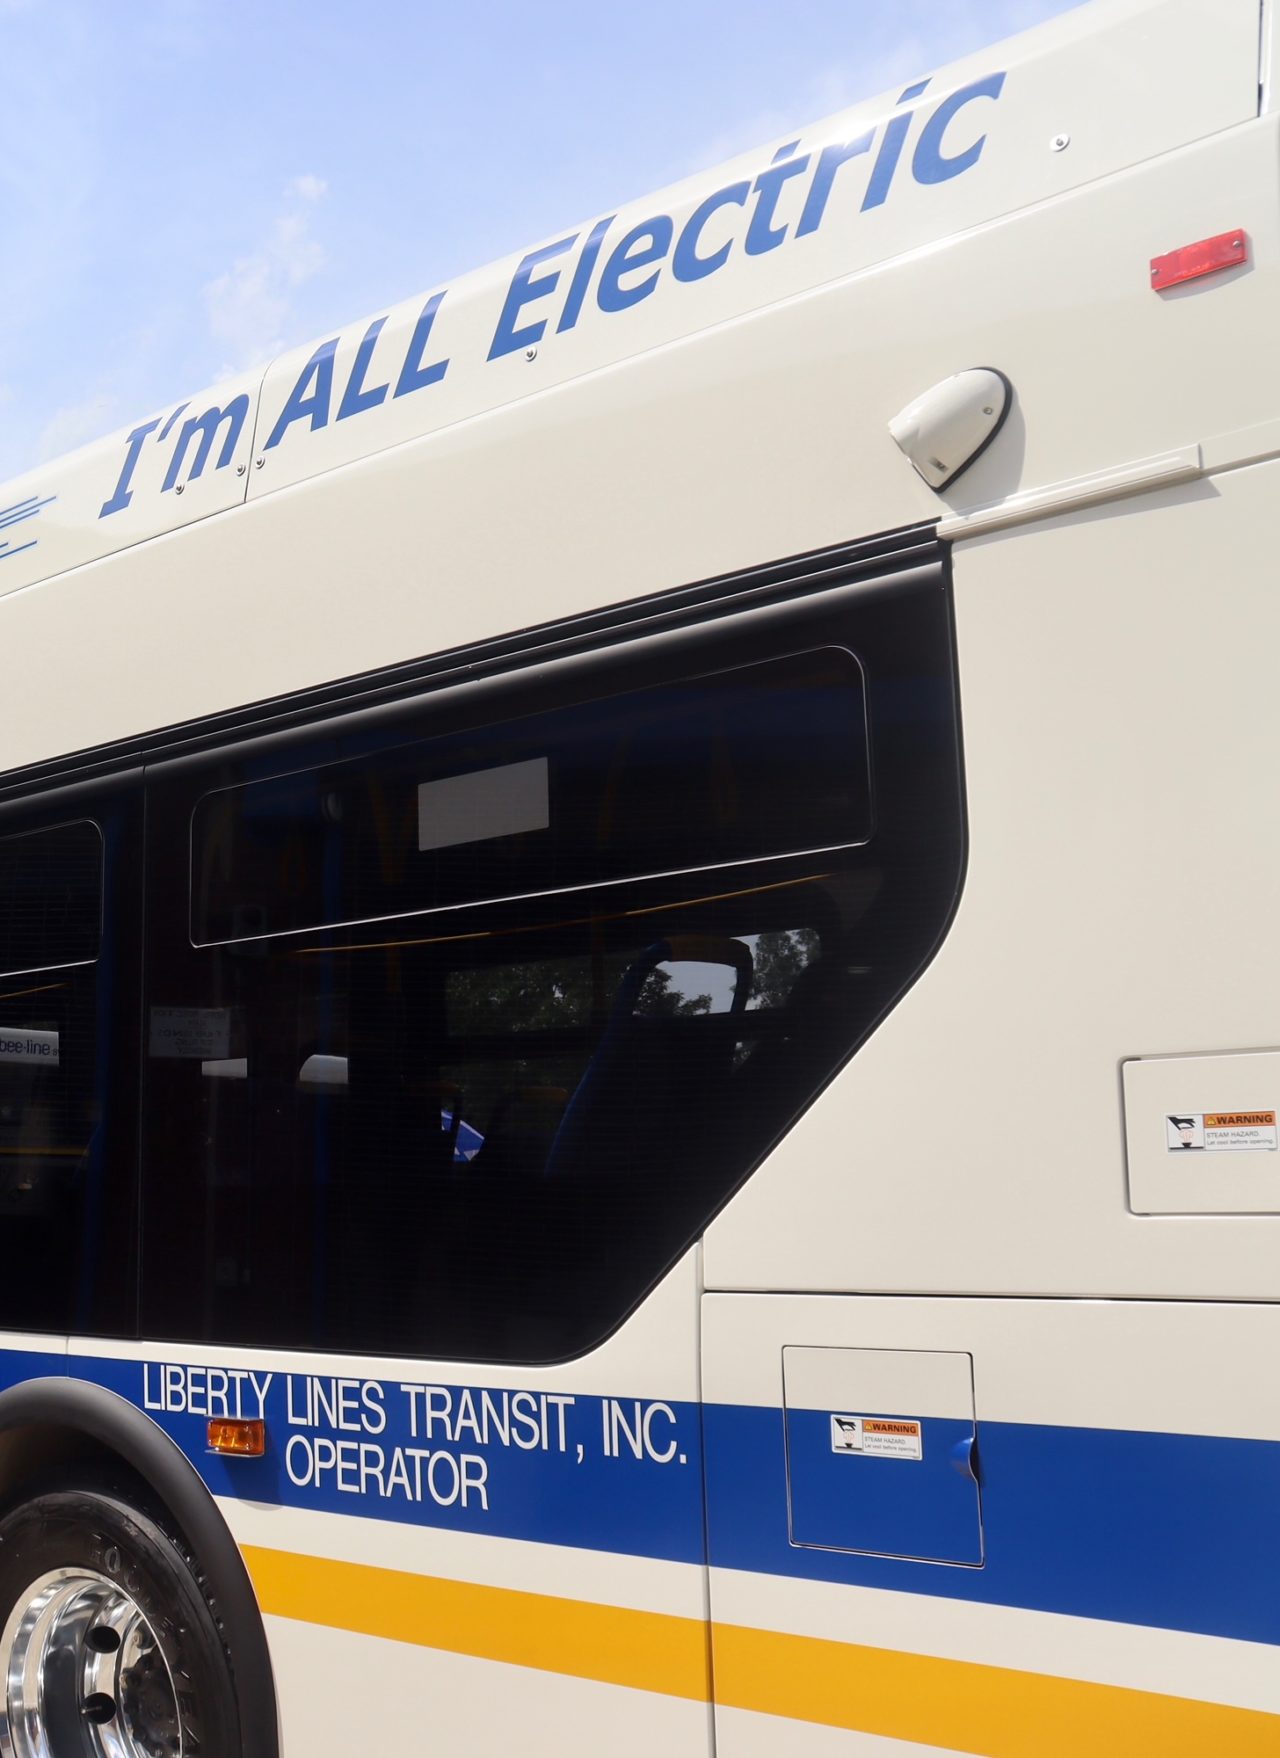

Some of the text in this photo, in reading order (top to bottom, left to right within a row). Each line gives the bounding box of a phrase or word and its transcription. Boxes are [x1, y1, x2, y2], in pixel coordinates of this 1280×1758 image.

[98, 71, 1007, 519] I'm ALL Electric
[1216, 1114, 1273, 1125] WARNING
[143, 1362, 687, 1465] LIBERTY LINES TRANSIT, INC.
[872, 1423, 917, 1434] WARNING
[285, 1434, 489, 1511] OPERATOR
